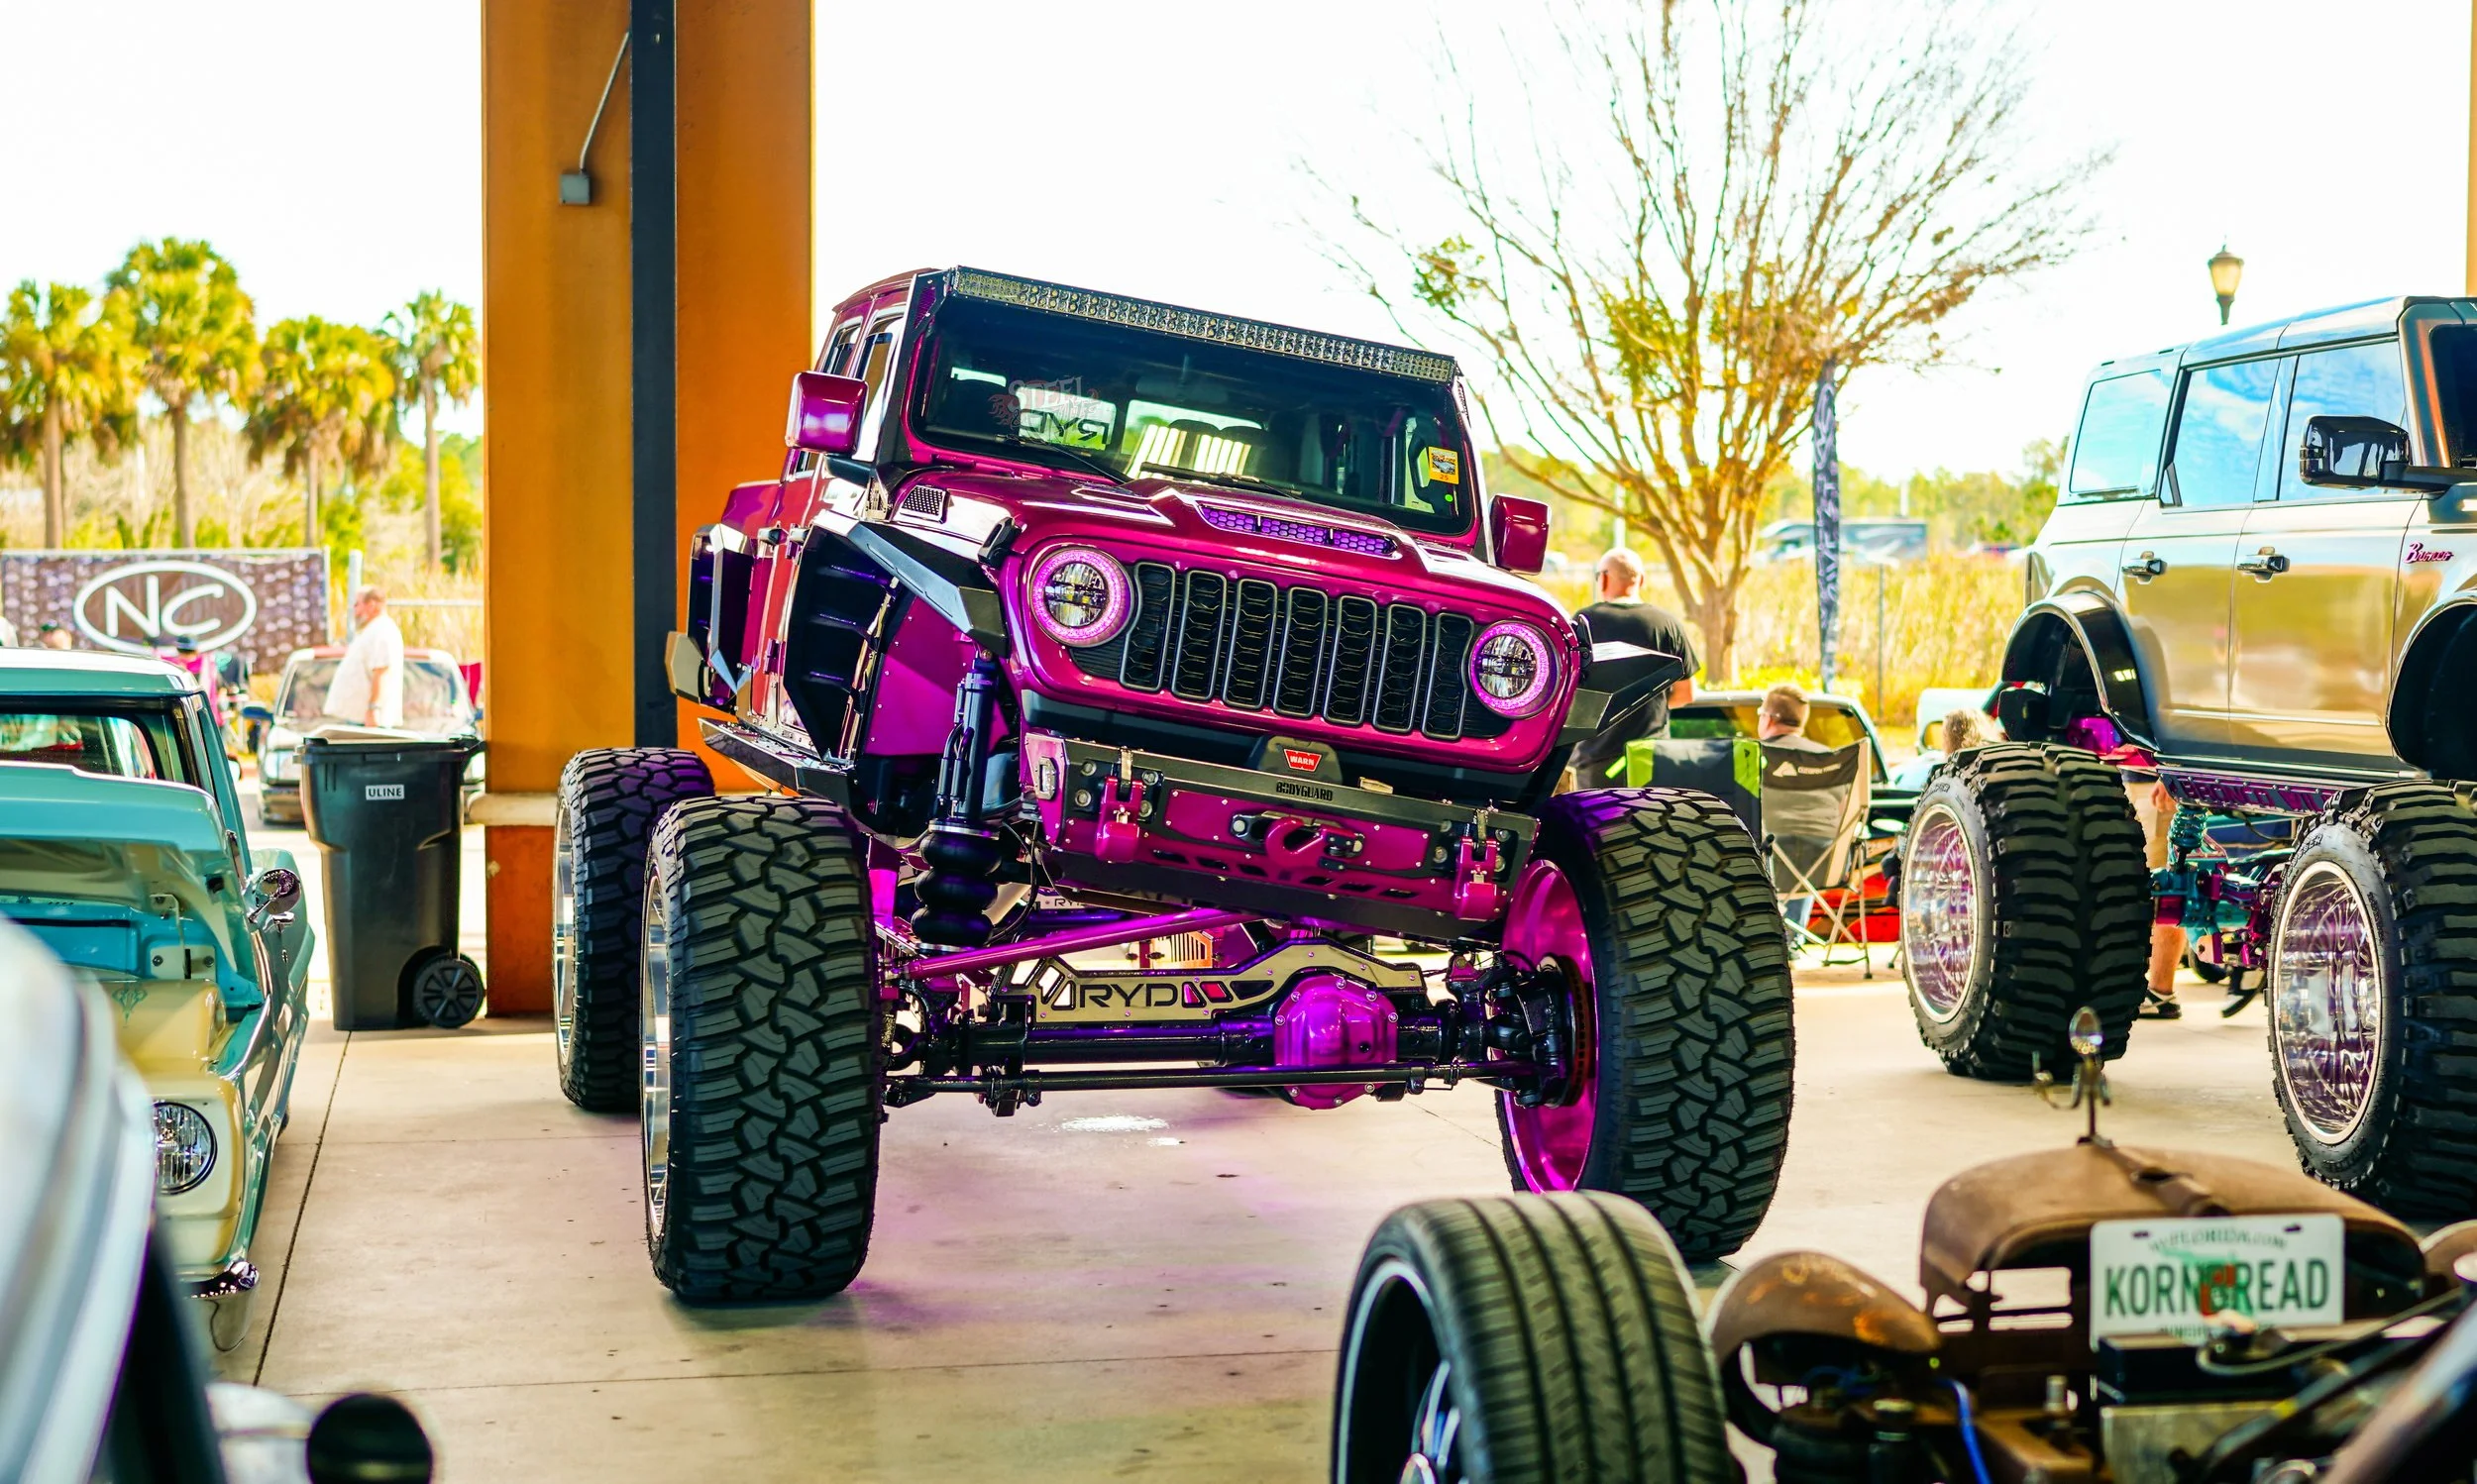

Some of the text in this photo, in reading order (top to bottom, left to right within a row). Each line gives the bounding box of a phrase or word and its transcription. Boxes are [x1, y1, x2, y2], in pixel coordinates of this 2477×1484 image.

[2404, 542, 2454, 564] Bronco
[105, 574, 225, 638] NC
[1290, 755, 1315, 767] WARN
[368, 788, 402, 797] ULINE
[1276, 782, 1334, 801] BODYGUARD
[1079, 983, 1178, 1008] RYD
